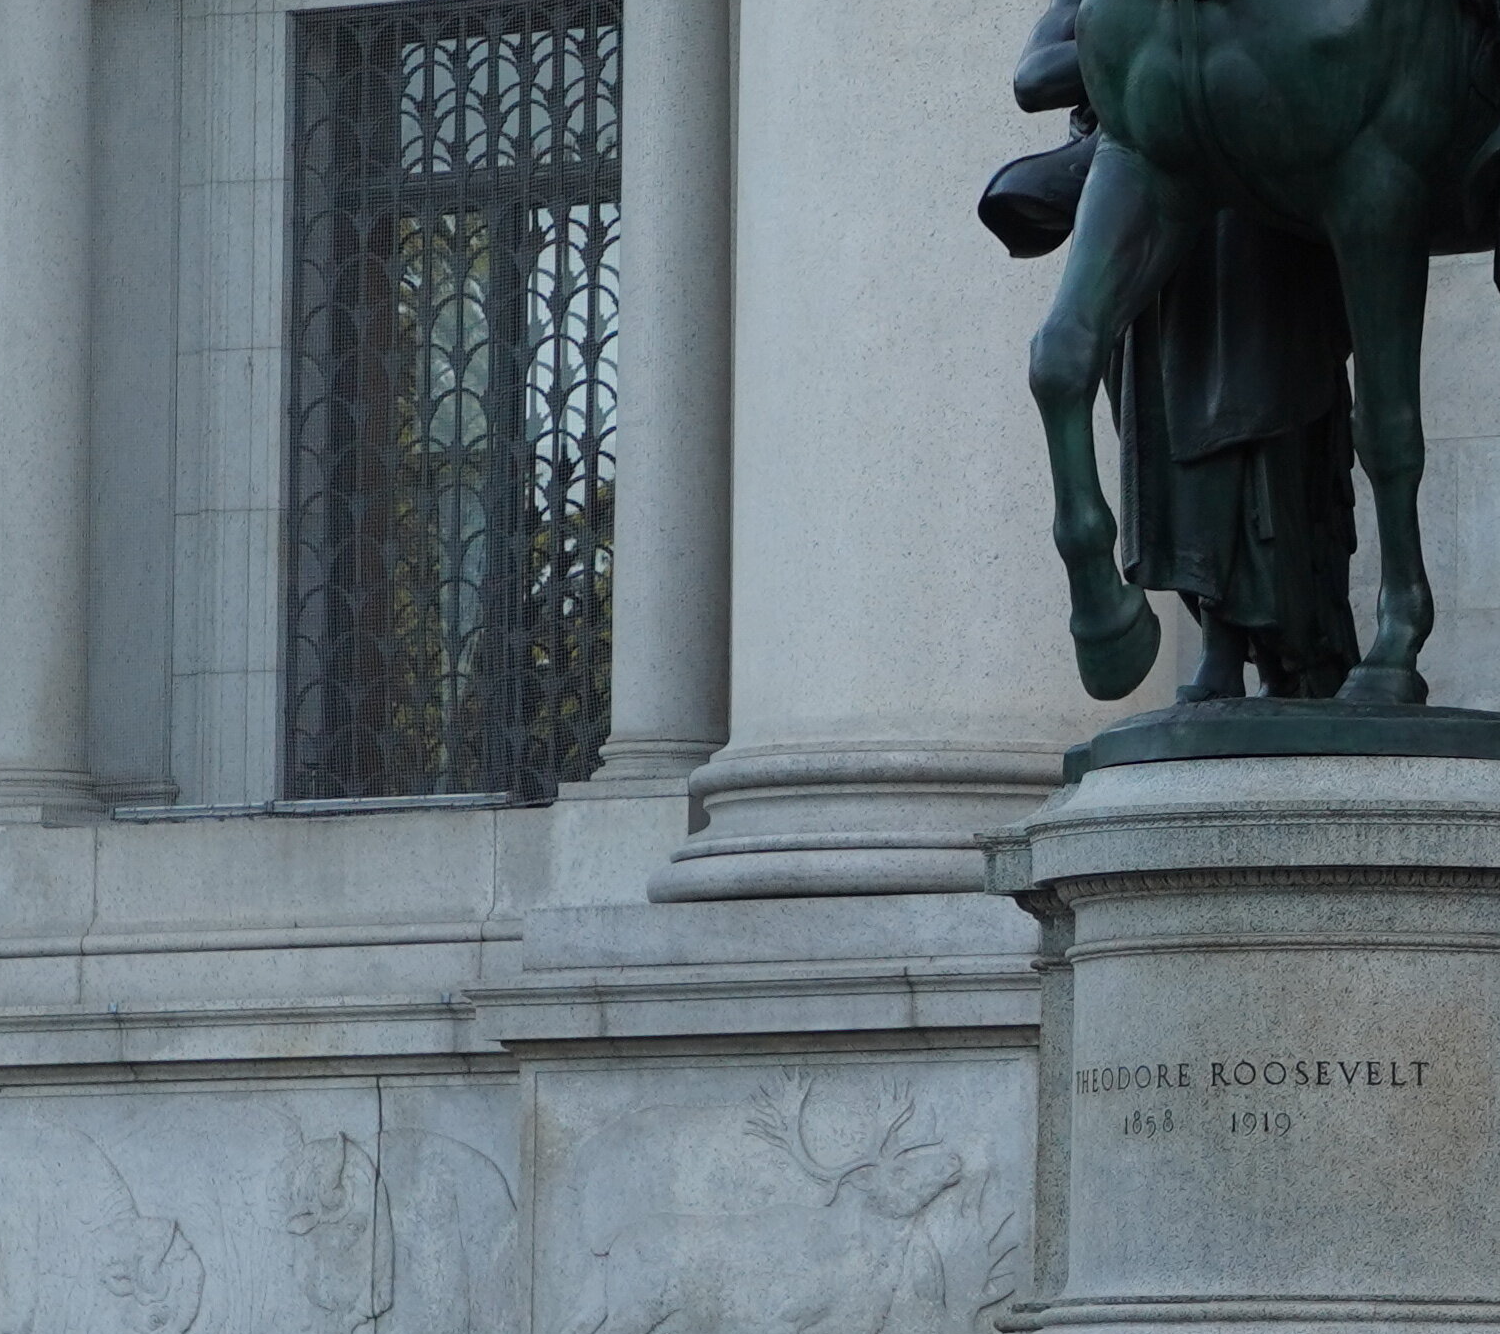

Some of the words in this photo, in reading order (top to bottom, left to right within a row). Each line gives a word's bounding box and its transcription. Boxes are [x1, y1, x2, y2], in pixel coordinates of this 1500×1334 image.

[1076, 1063, 1191, 1094] THEODORE
[1211, 1061, 1430, 1087] ROOSEVELT
[1123, 1109, 1174, 1138] 1858
[1231, 1112, 1291, 1137] 1919
